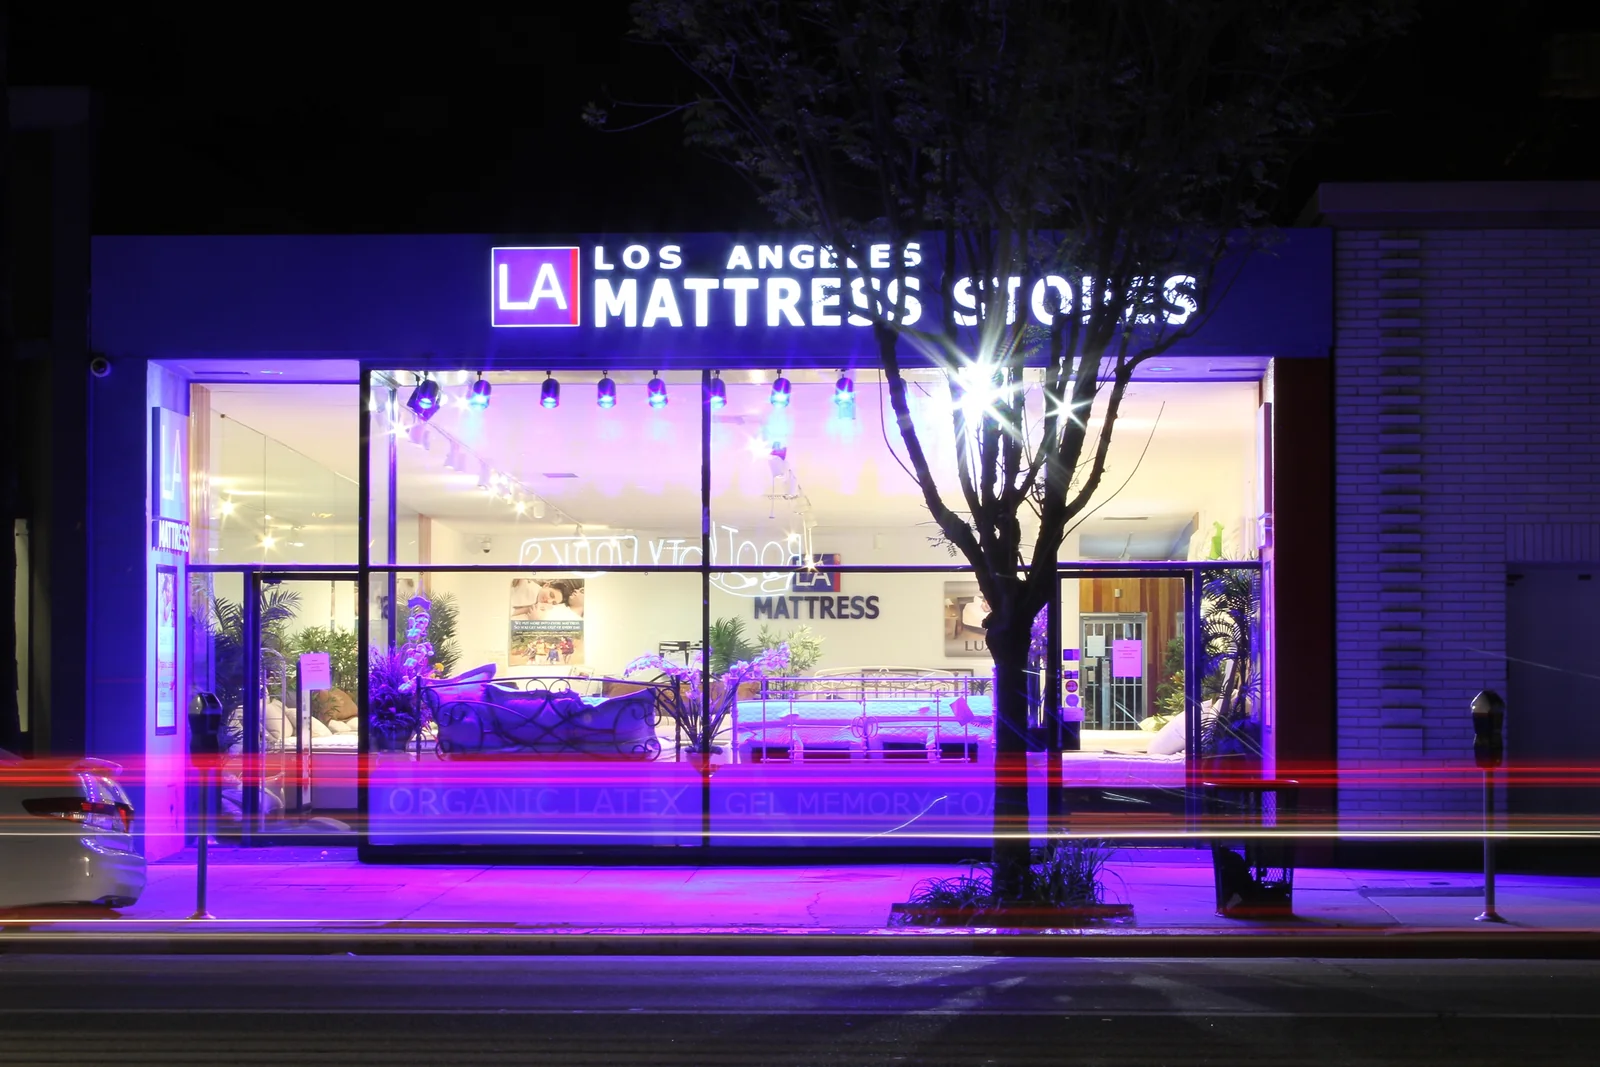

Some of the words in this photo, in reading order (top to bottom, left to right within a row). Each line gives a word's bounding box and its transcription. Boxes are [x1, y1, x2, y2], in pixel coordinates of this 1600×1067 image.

[595, 244, 682, 270] LOS
[498, 263, 568, 310] LA
[595, 276, 922, 328] MATTRESS
[161, 424, 186, 504] LA
[159, 519, 190, 553] MATTRESS
[795, 559, 832, 587] LA
[754, 595, 880, 620] MATTRESS
[964, 640, 989, 652] LU
[388, 786, 560, 816] ORGANIC
[574, 785, 686, 816] LATEX
[725, 791, 785, 816] GEL
[796, 791, 931, 816] MEMORY
